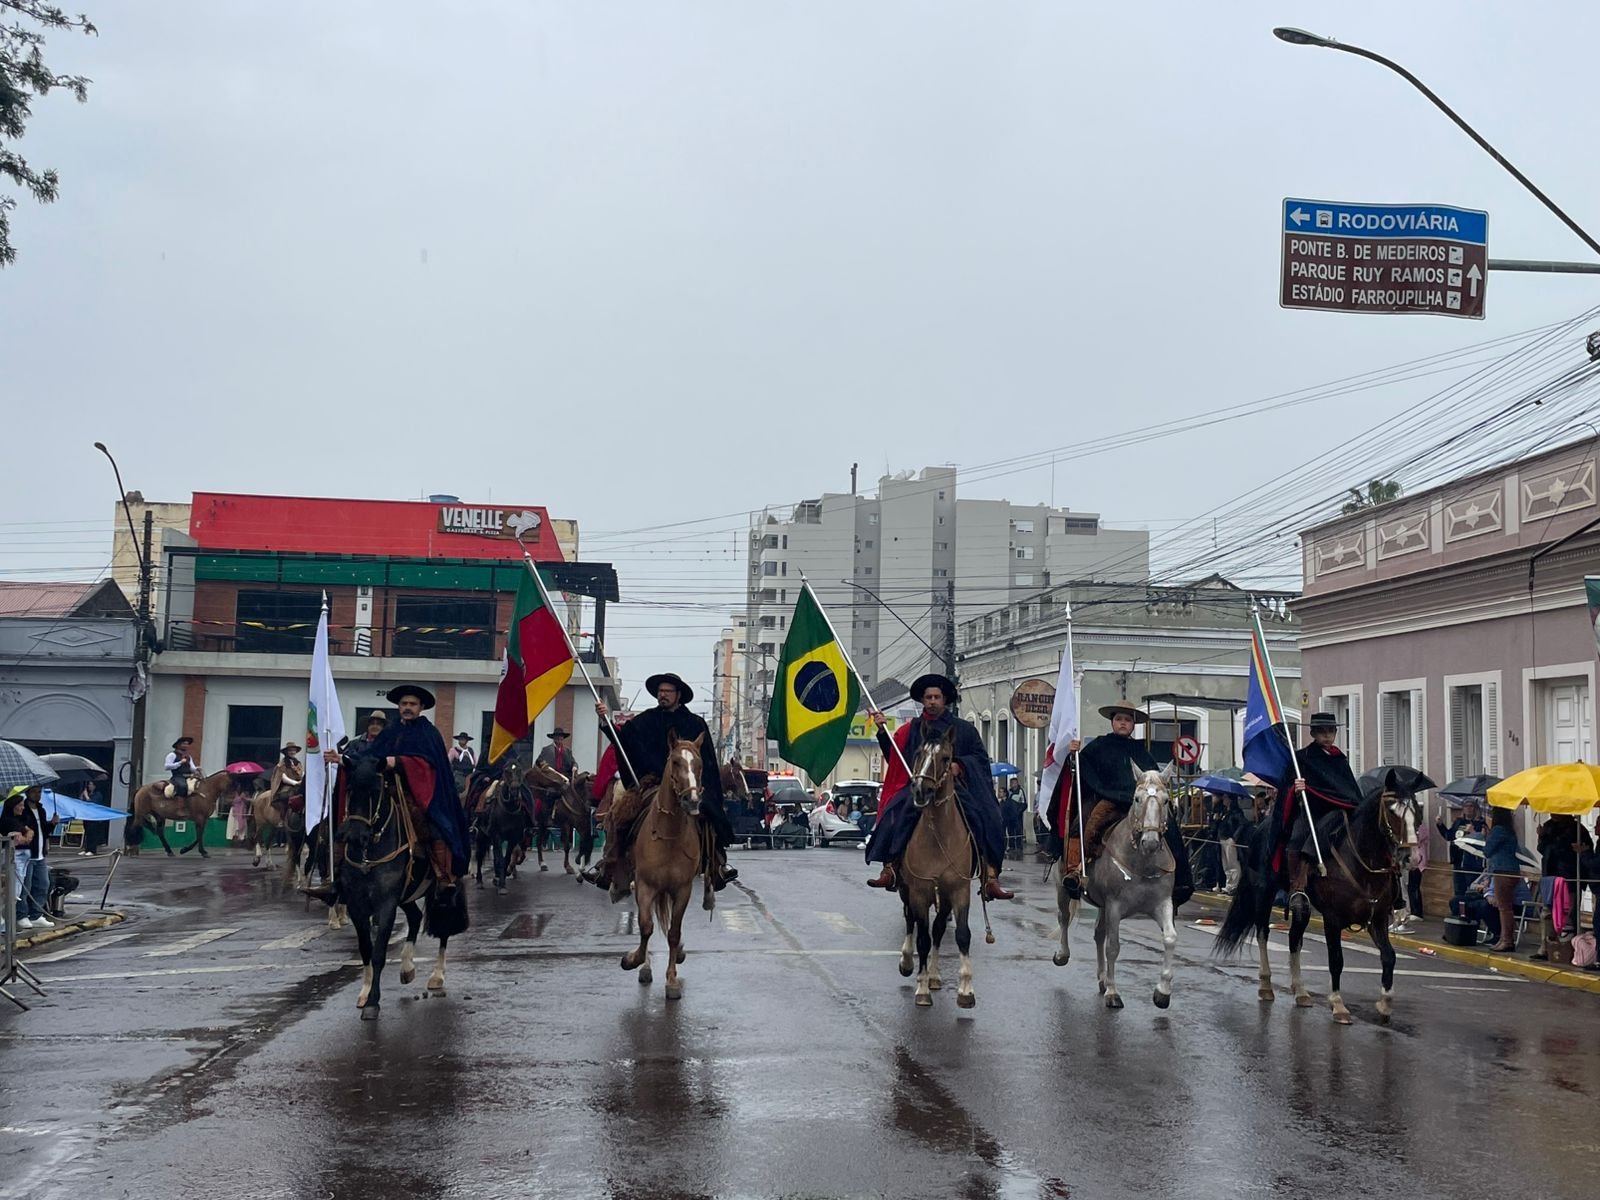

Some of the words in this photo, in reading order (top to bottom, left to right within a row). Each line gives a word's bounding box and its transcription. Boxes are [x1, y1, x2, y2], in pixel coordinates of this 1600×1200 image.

[1338, 211, 1459, 232] RODOVIÁRIA
[1291, 240, 1332, 257] PONTE
[1337, 244, 1349, 258] B.
[1354, 245, 1371, 260] DE
[1377, 245, 1446, 261] MEDEIROS
[1291, 262, 1346, 280] PARQUE
[1353, 267, 1384, 282] RUY
[1391, 268, 1445, 283] RAMOS
[1292, 283, 1345, 303] ESTÁDIO
[1351, 290, 1443, 306] FARROUPILHA
[442, 507, 503, 529] VENELLE
[1025, 704, 1049, 714] BEER
